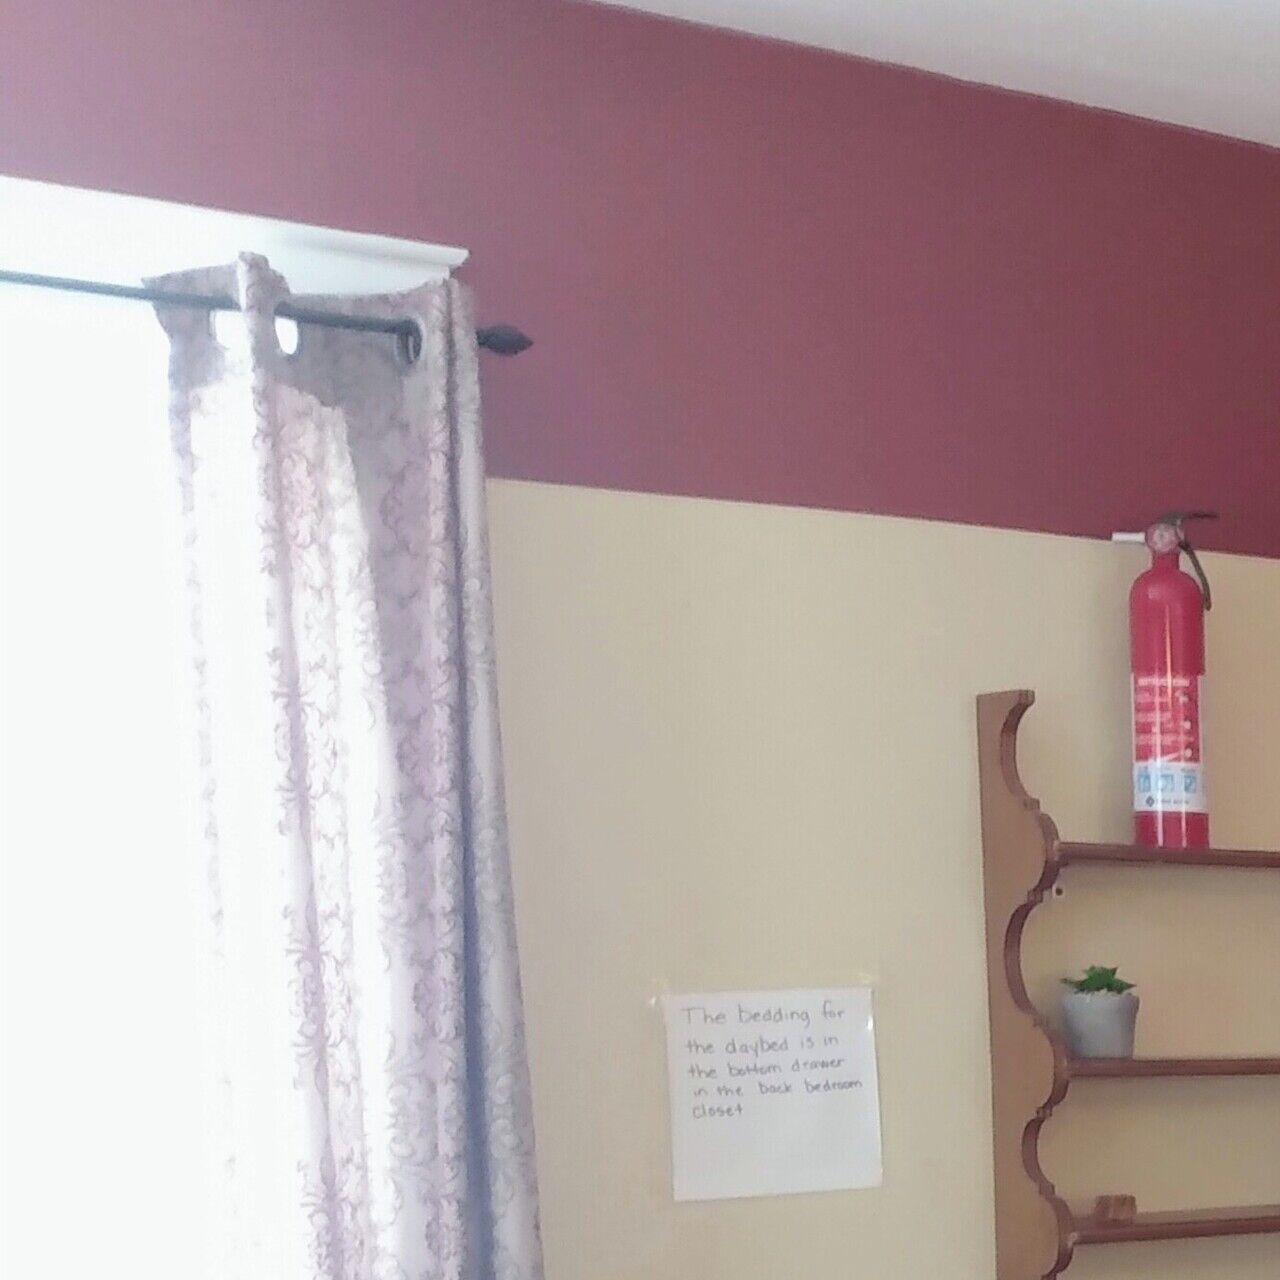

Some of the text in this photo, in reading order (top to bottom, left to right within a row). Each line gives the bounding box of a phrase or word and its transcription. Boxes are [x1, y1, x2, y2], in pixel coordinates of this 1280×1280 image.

[680, 1000, 847, 1028] The bedding for
[686, 1035, 839, 1057] the daybed is in
[687, 1058, 846, 1079] the bottom drawer
[693, 1078, 864, 1098] in the back bedroom
[692, 1103, 744, 1119] closet
